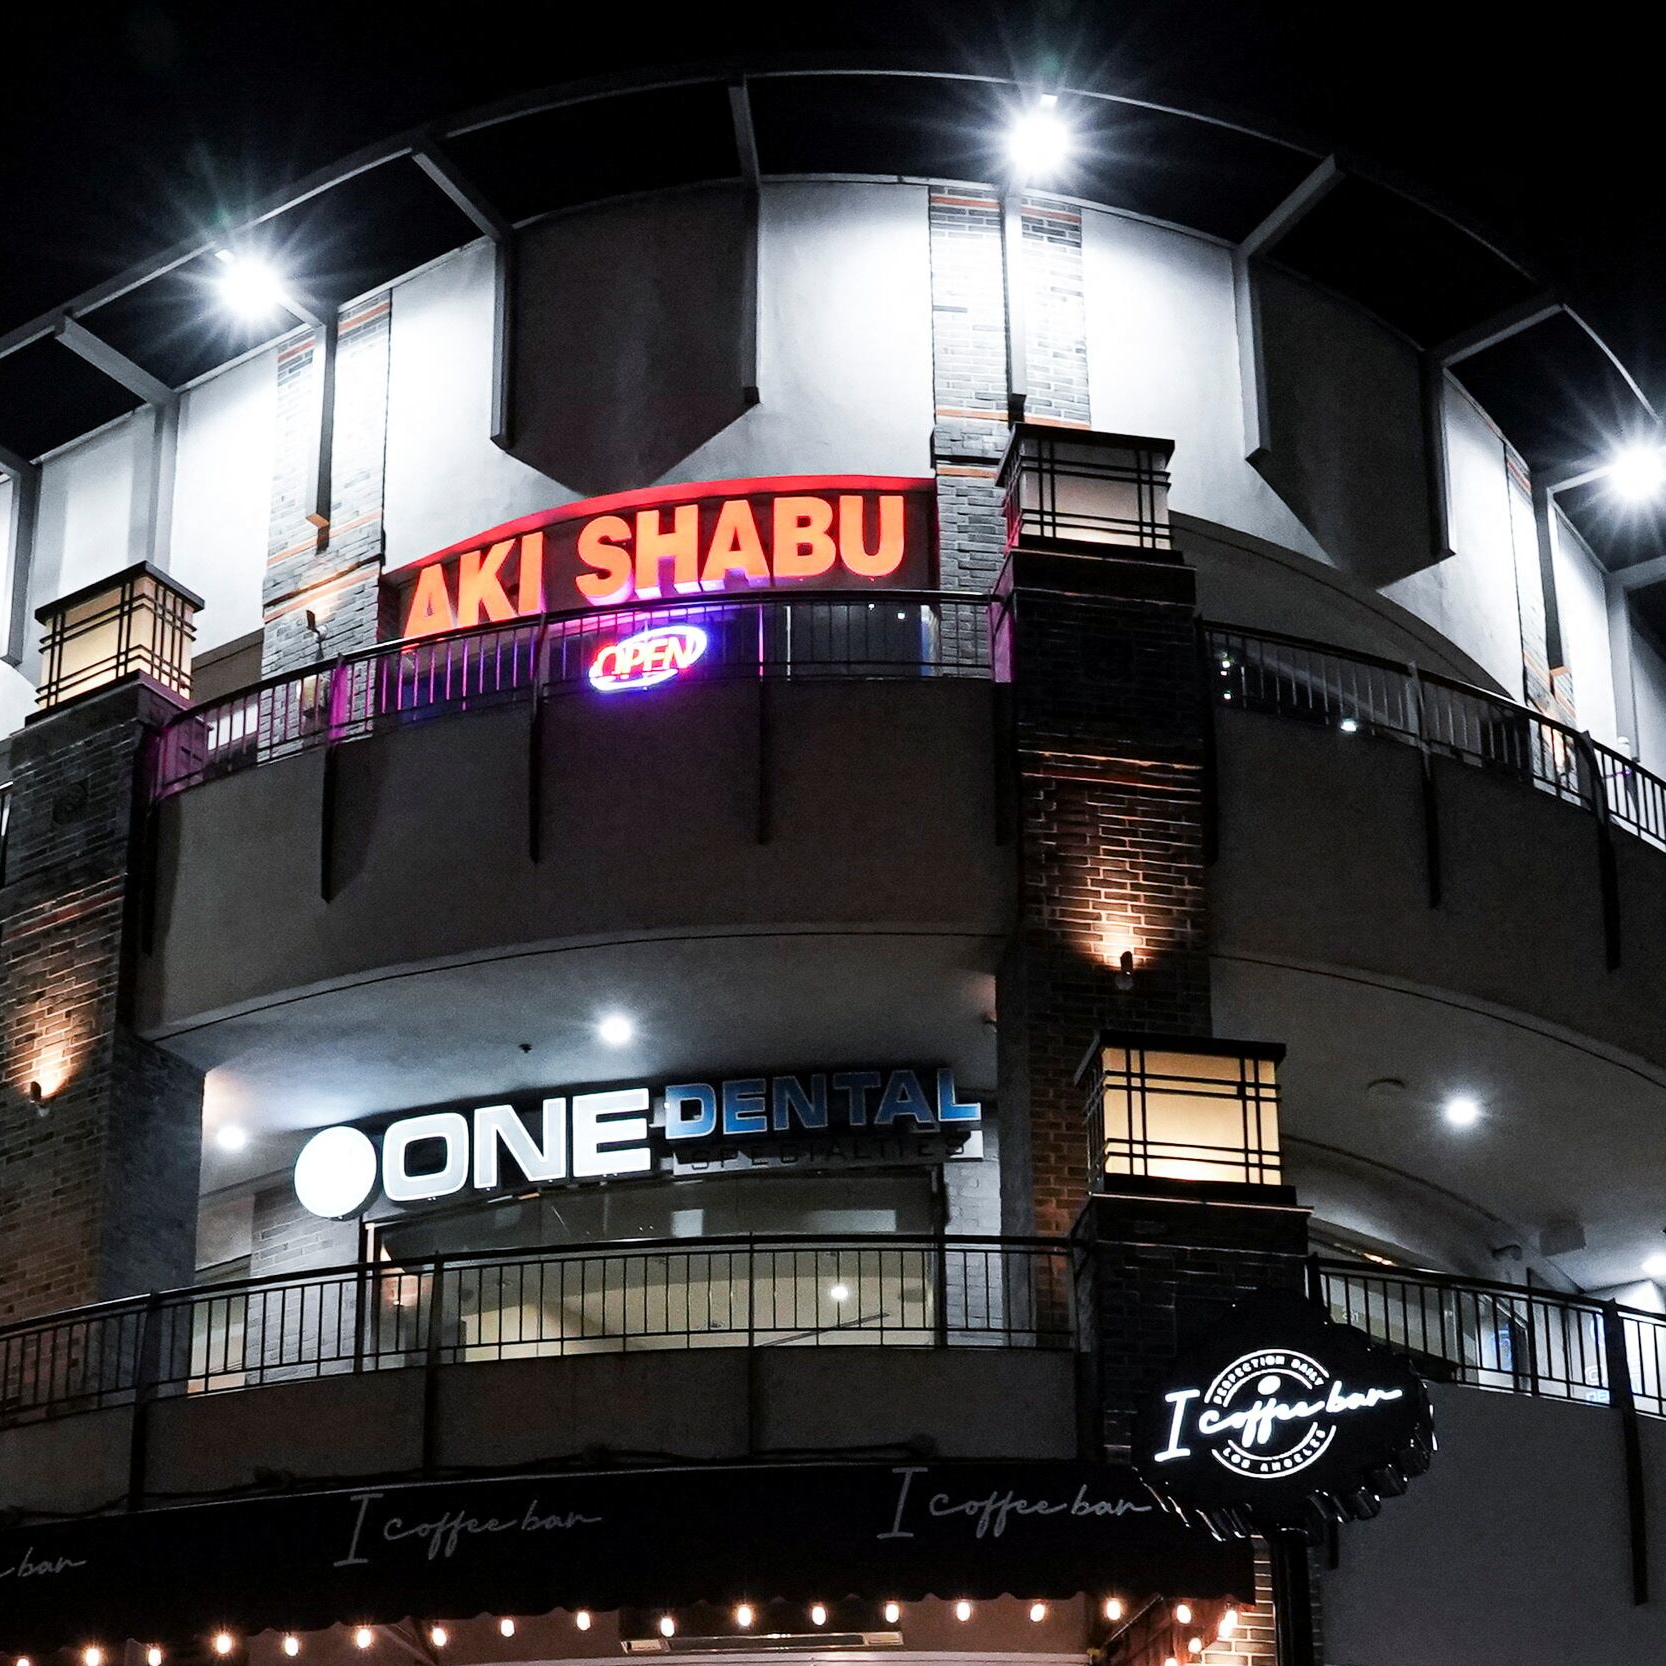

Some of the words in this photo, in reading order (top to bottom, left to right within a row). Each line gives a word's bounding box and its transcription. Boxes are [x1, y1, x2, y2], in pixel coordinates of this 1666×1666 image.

[403, 531, 546, 640] AKI
[575, 495, 905, 606] SHABU
[595, 635, 696, 680] OPEN
[381, 1088, 652, 1202] ONE
[664, 1068, 982, 1141] DENTAL
[1153, 1389, 1201, 1462] I
[333, 1493, 384, 1567] I
[877, 1466, 928, 1539] I
